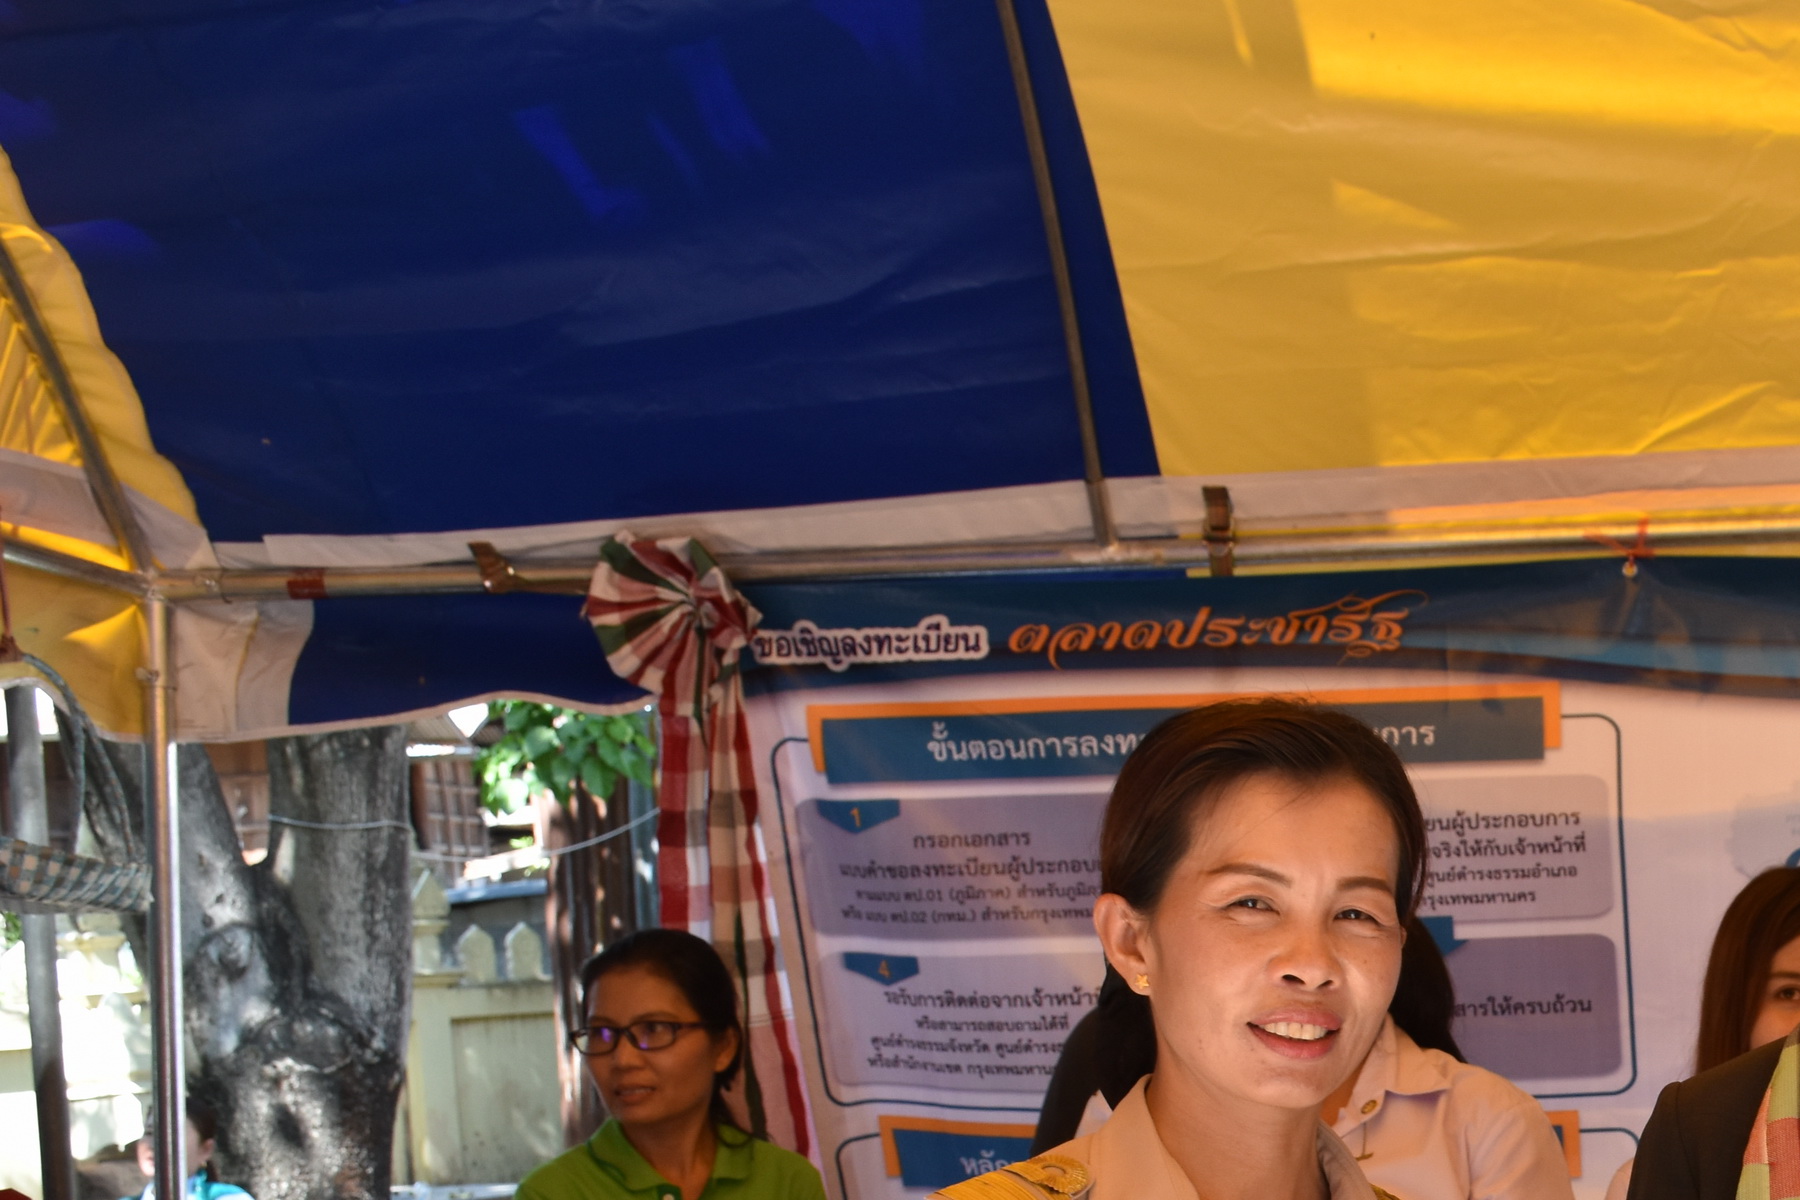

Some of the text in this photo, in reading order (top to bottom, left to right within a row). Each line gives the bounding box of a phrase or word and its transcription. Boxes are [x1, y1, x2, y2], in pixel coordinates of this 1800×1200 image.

[753, 589, 1429, 671] ขอเชิญลงทะเบียน ตลาดประชารัฐ
[927, 721, 1438, 762] ขั้นตอนการลงท การ
[850, 807, 862, 828] 1
[913, 831, 1031, 849] กรอกเอกสาร
[840, 854, 1101, 881] แบบคำขอลงทะเบียนผู้ประกอบ
[877, 959, 892, 979] 4
